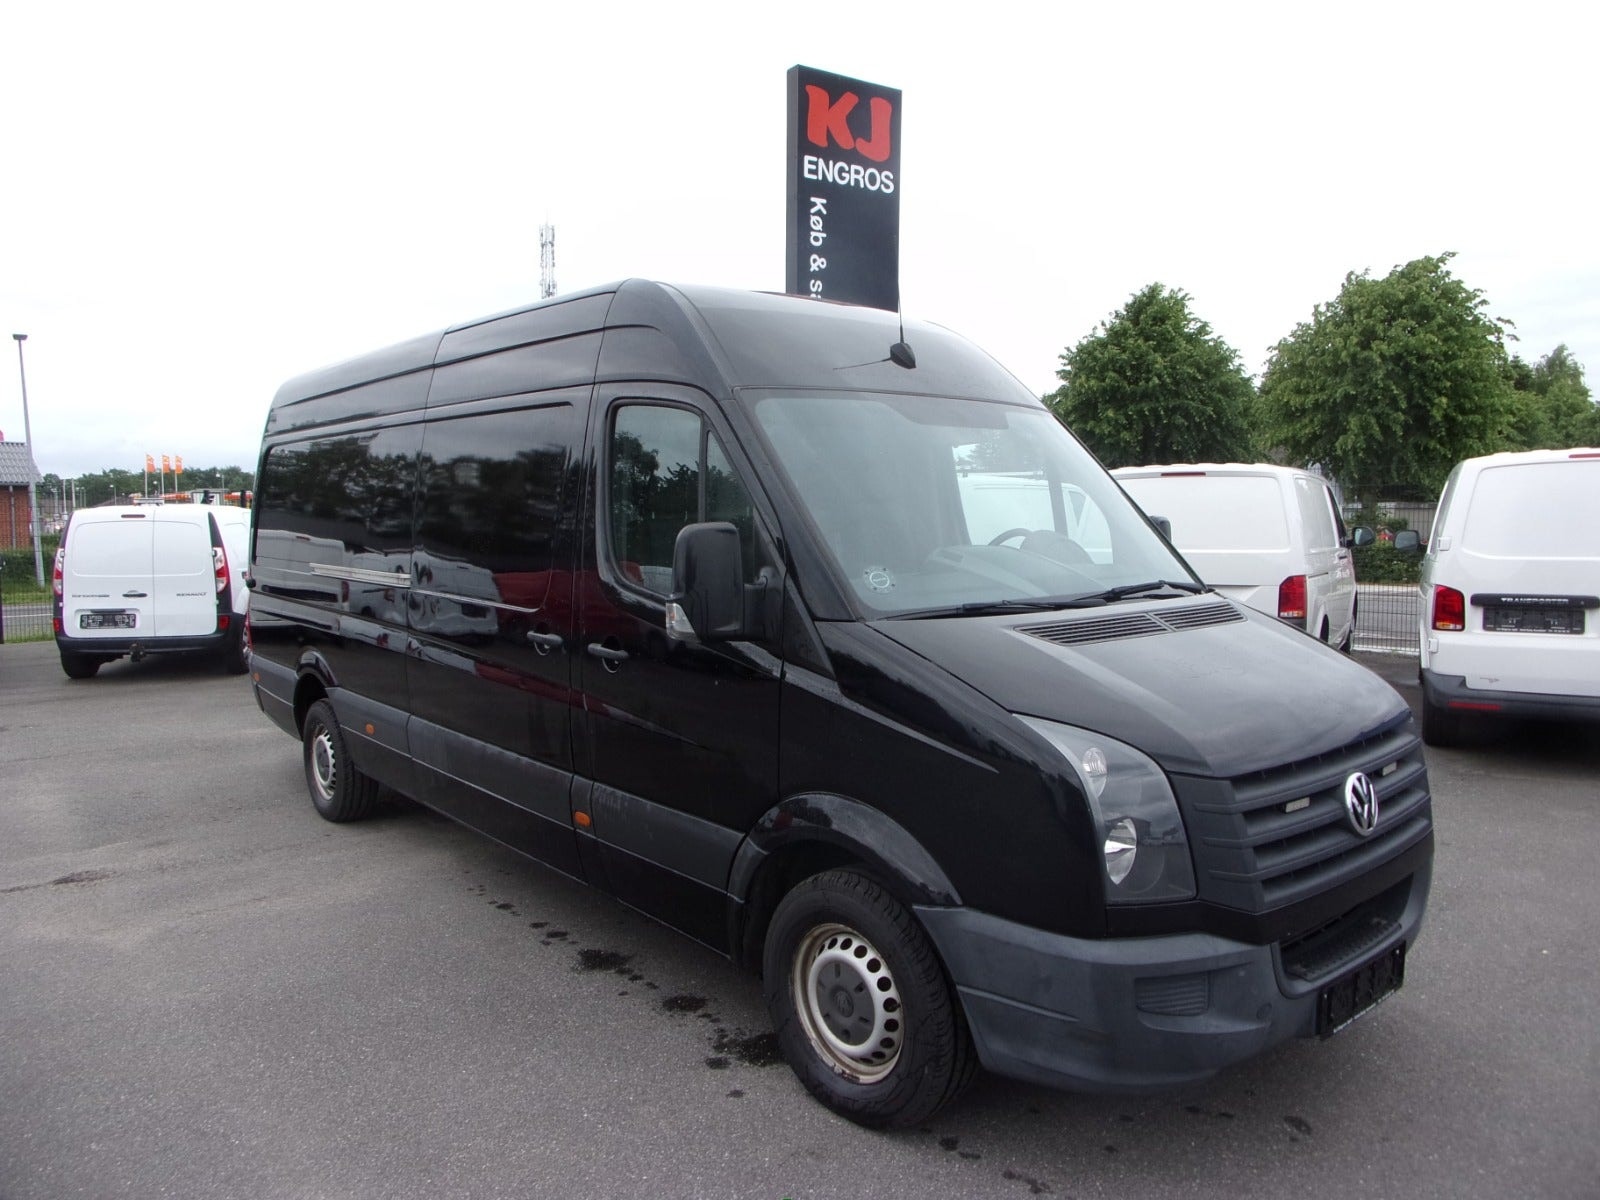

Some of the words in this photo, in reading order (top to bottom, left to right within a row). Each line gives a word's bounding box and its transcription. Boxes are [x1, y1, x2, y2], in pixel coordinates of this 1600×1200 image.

[804, 84, 893, 163] KJ
[803, 155, 895, 194] ENGROS
[809, 196, 827, 247] Køb
[809, 253, 827, 272] &
[809, 279, 823, 298] s
